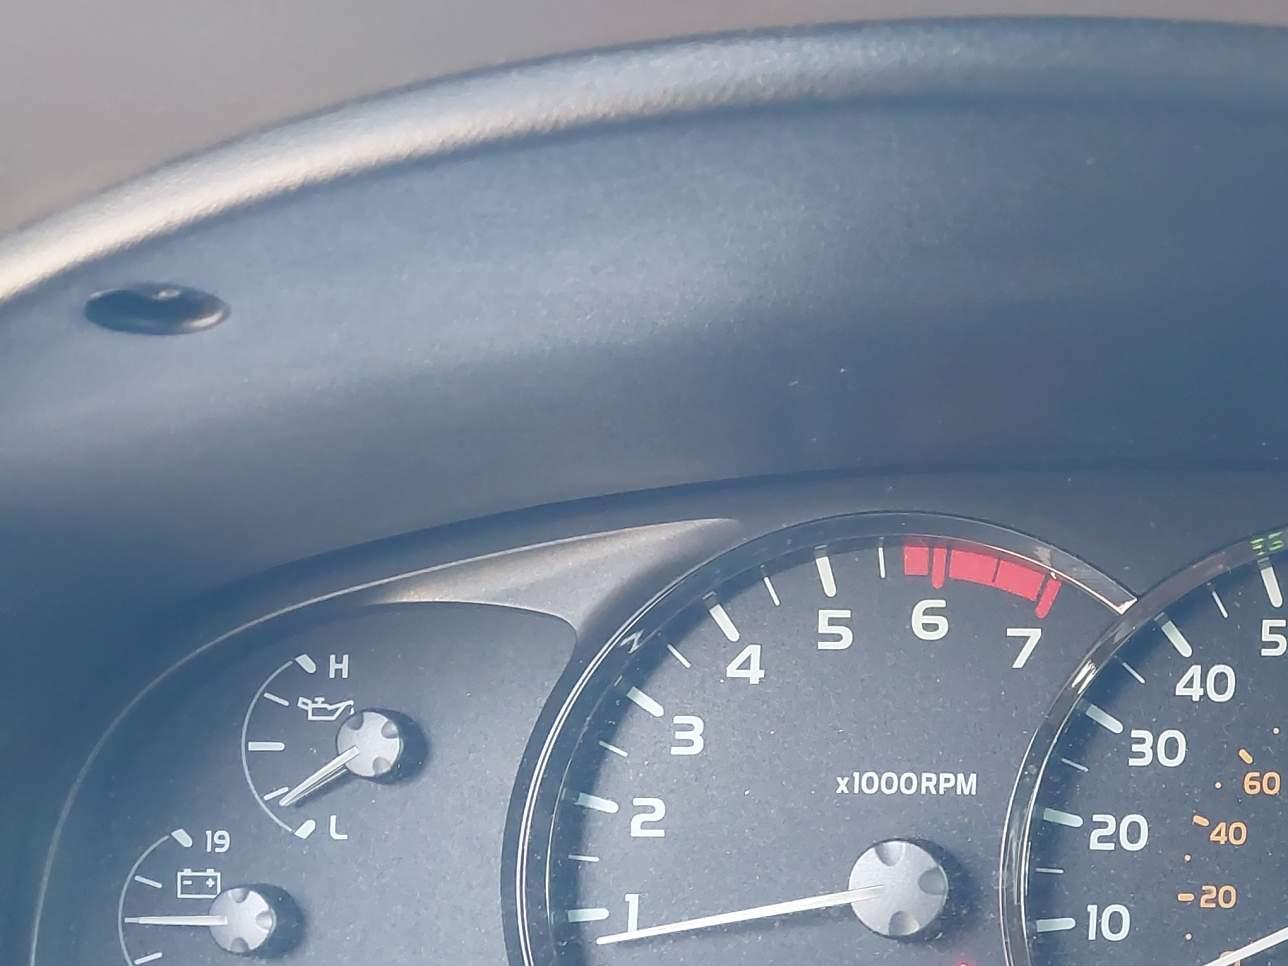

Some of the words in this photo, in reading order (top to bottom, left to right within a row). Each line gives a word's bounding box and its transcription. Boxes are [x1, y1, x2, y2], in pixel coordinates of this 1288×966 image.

[817, 609, 853, 650] 5
[911, 599, 949, 641] 6
[328, 654, 349, 679] H
[726, 644, 766, 685] 4
[1006, 627, 1042, 669] 7
[1175, 664, 1236, 702] 40
[670, 715, 704, 756] 3
[1128, 729, 1187, 767] 30
[1243, 771, 1281, 795] 60
[329, 814, 348, 840] L
[630, 797, 666, 837] 2
[1089, 813, 1149, 851] 20
[1209, 821, 1247, 845] 40
[205, 830, 231, 853] 19
[623, 892, 641, 939] 1
[1199, 885, 1237, 909] 20
[1086, 904, 1131, 941] 10
